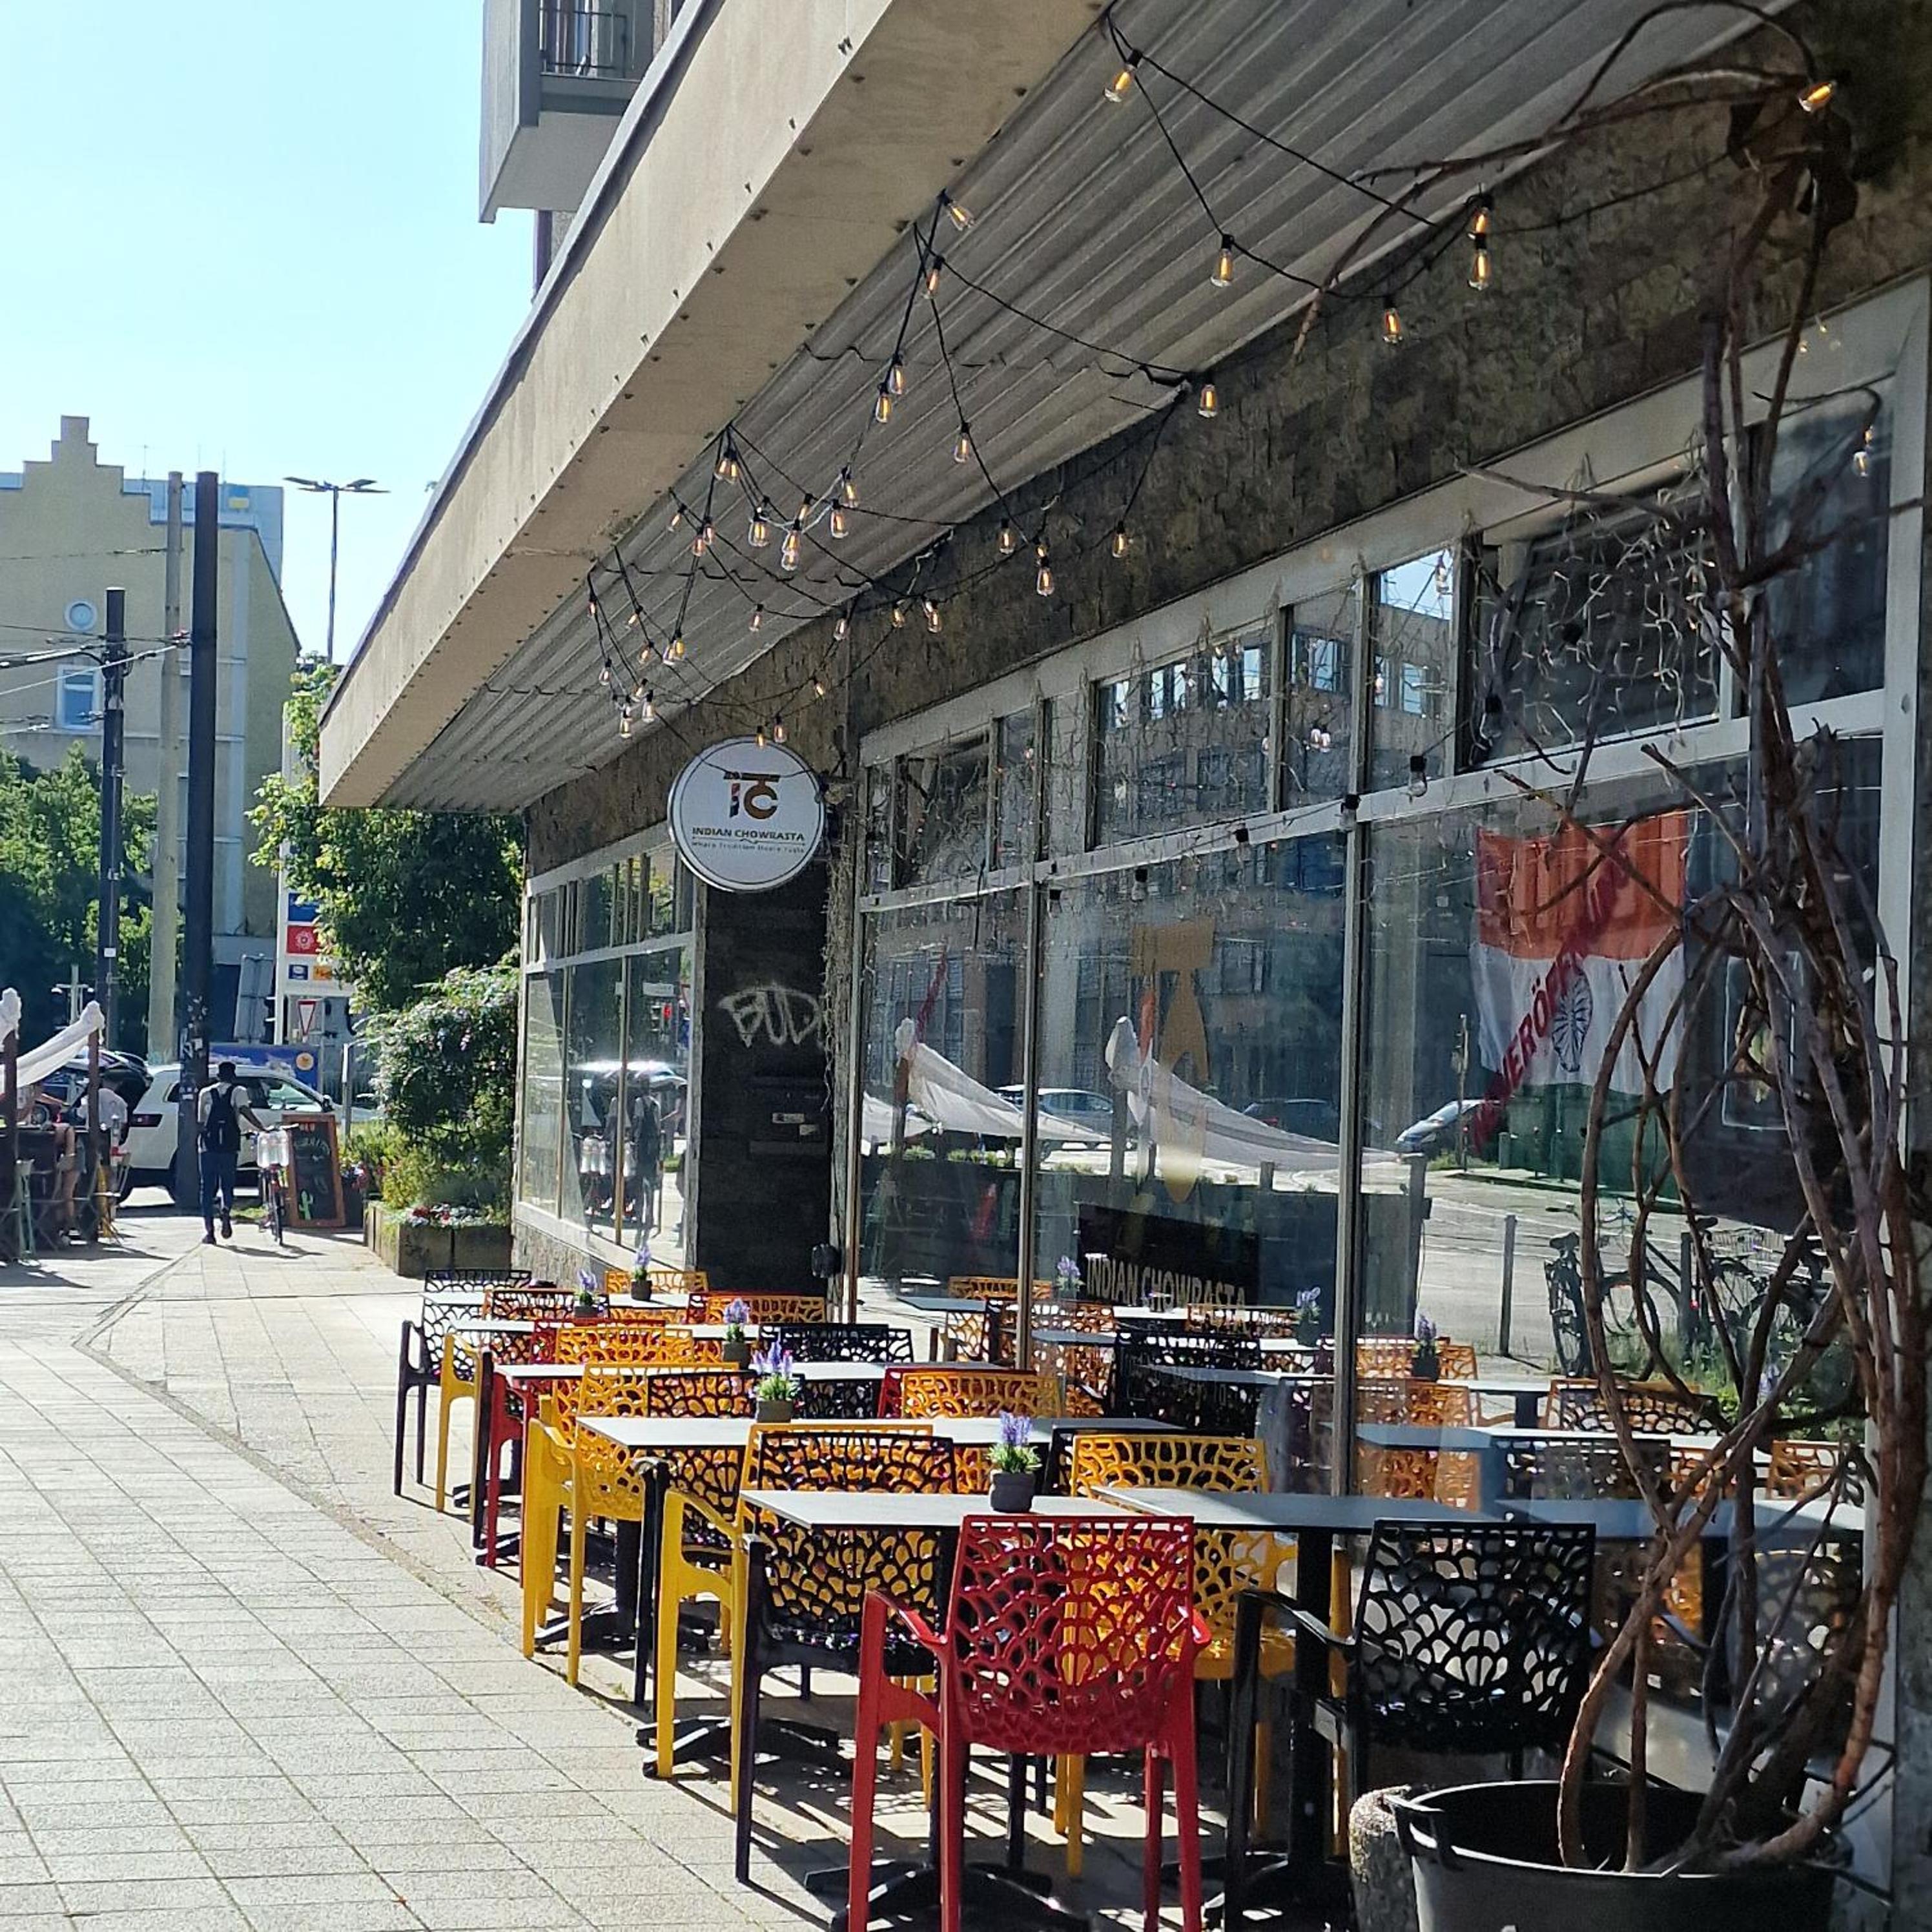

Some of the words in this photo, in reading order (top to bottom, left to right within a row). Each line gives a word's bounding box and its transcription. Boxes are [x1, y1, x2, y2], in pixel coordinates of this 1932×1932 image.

[692, 827, 732, 837] INDIAN
[734, 829, 805, 841] CHOWRASTA
[1087, 1254, 1138, 1307] INDIAN
